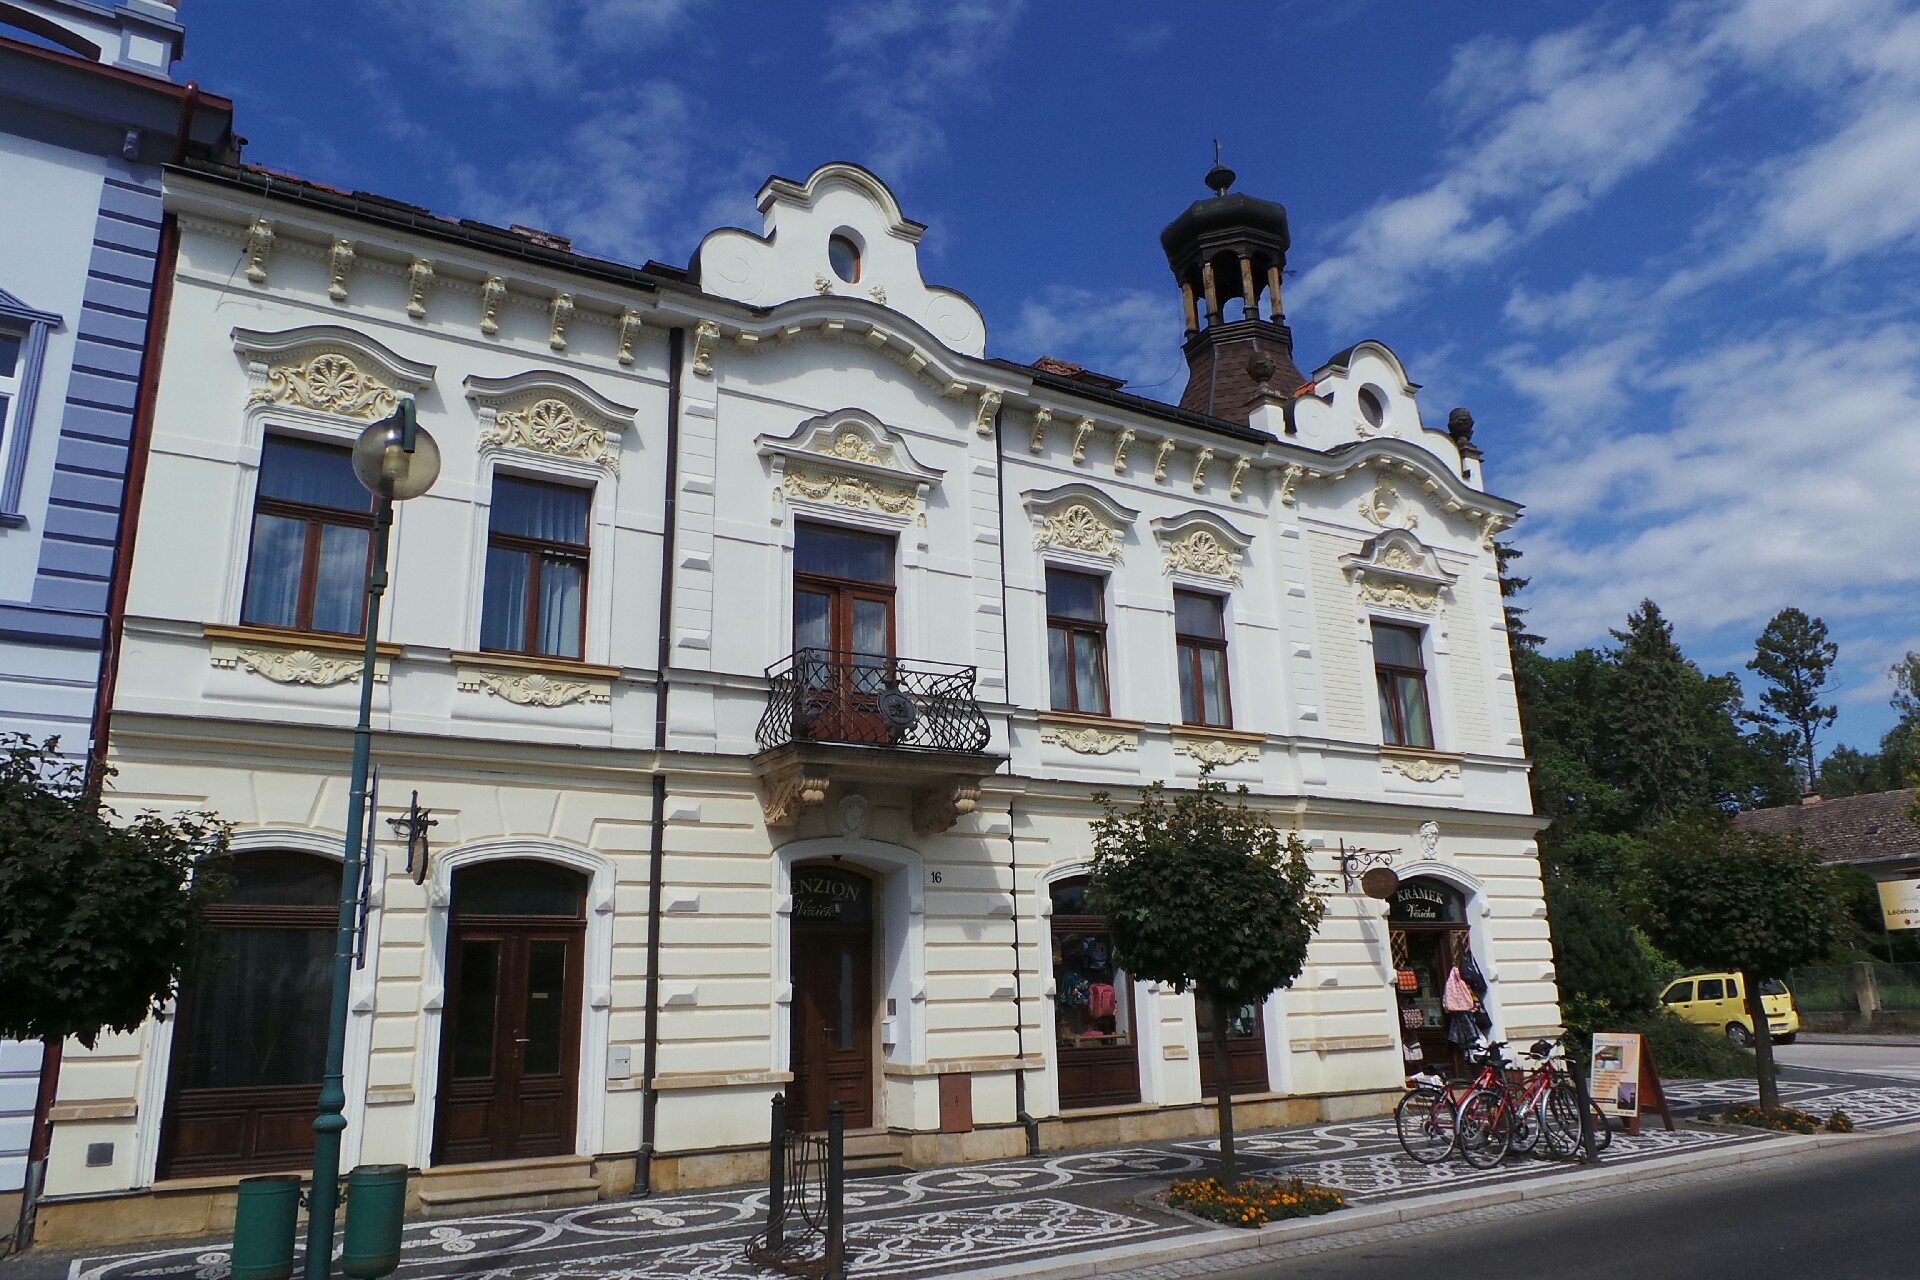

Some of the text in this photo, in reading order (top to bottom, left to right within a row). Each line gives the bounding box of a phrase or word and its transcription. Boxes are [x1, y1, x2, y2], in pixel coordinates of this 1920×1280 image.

[931, 871, 942, 884] 16
[791, 878, 860, 902] ENZION
[1396, 884, 1444, 905] KRÁMEK
